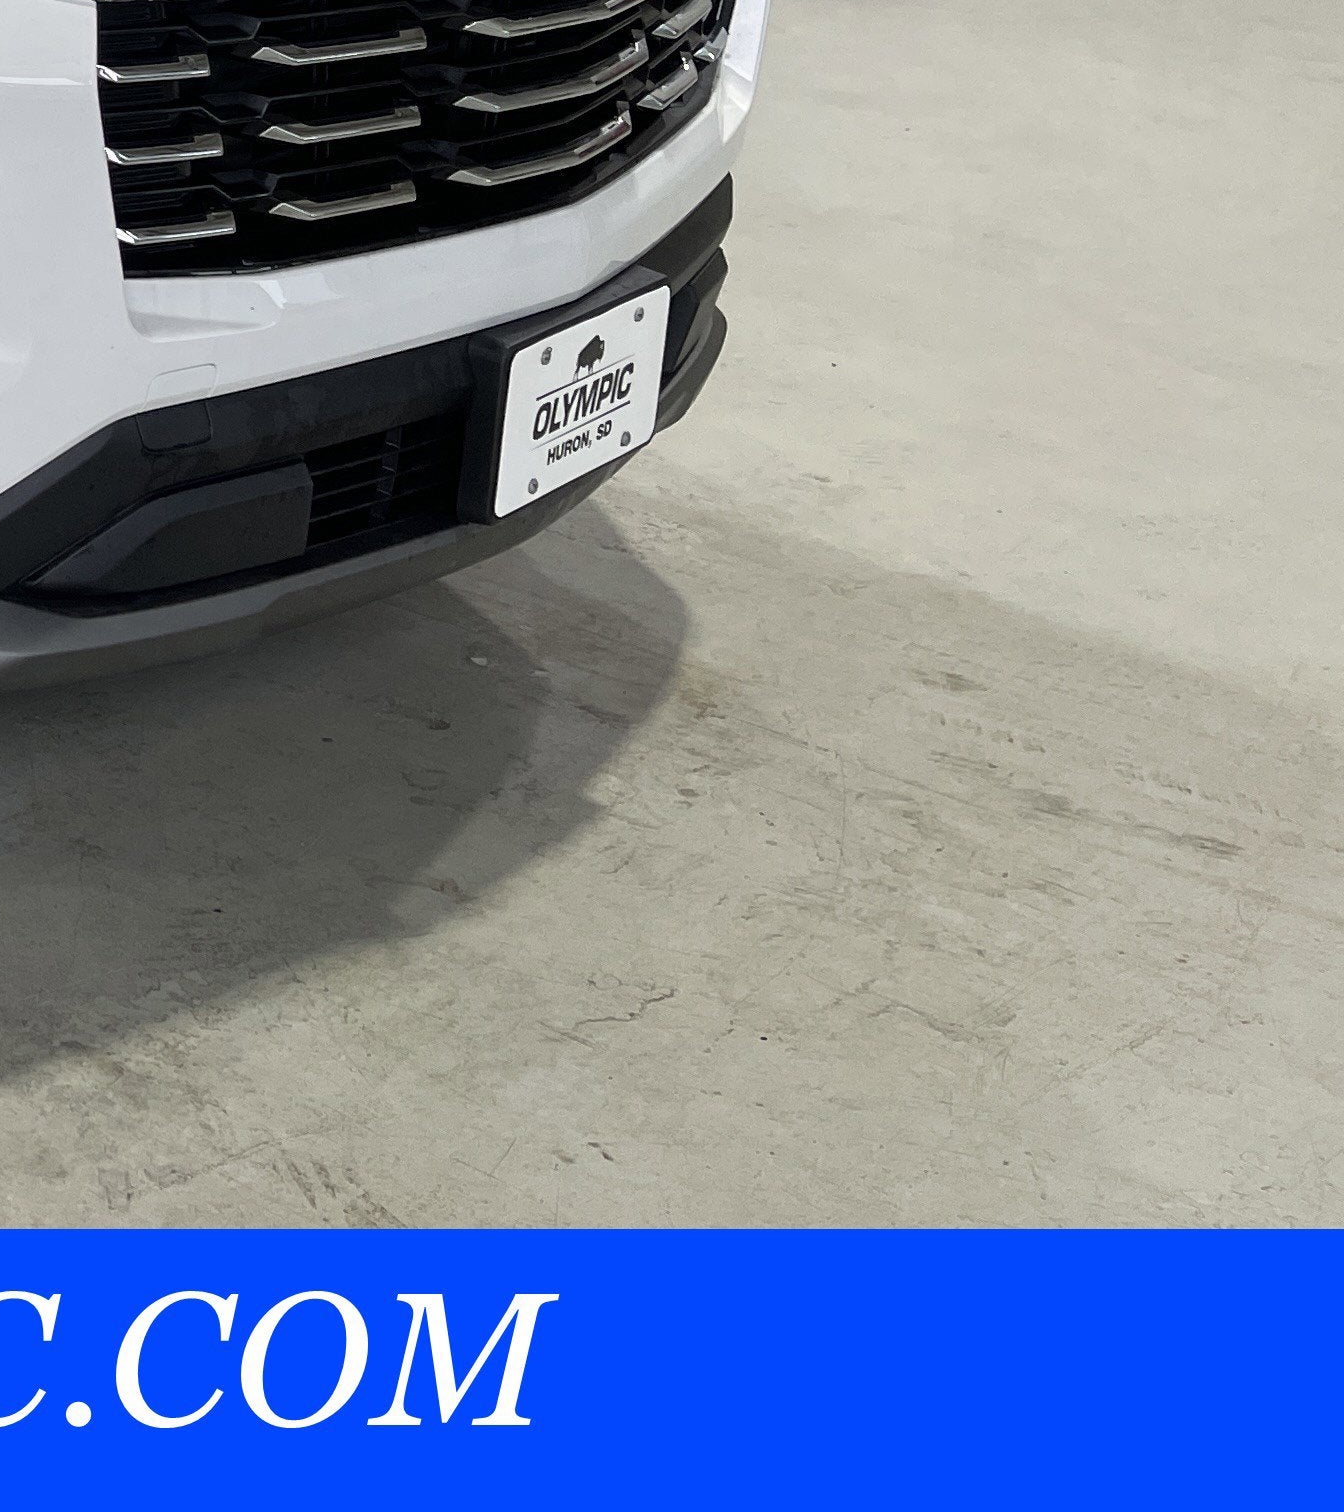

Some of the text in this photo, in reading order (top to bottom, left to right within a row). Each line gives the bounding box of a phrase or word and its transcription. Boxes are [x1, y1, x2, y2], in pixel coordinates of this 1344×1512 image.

[532, 362, 635, 441] OLYMPIC
[546, 419, 613, 466] HURON, SD
